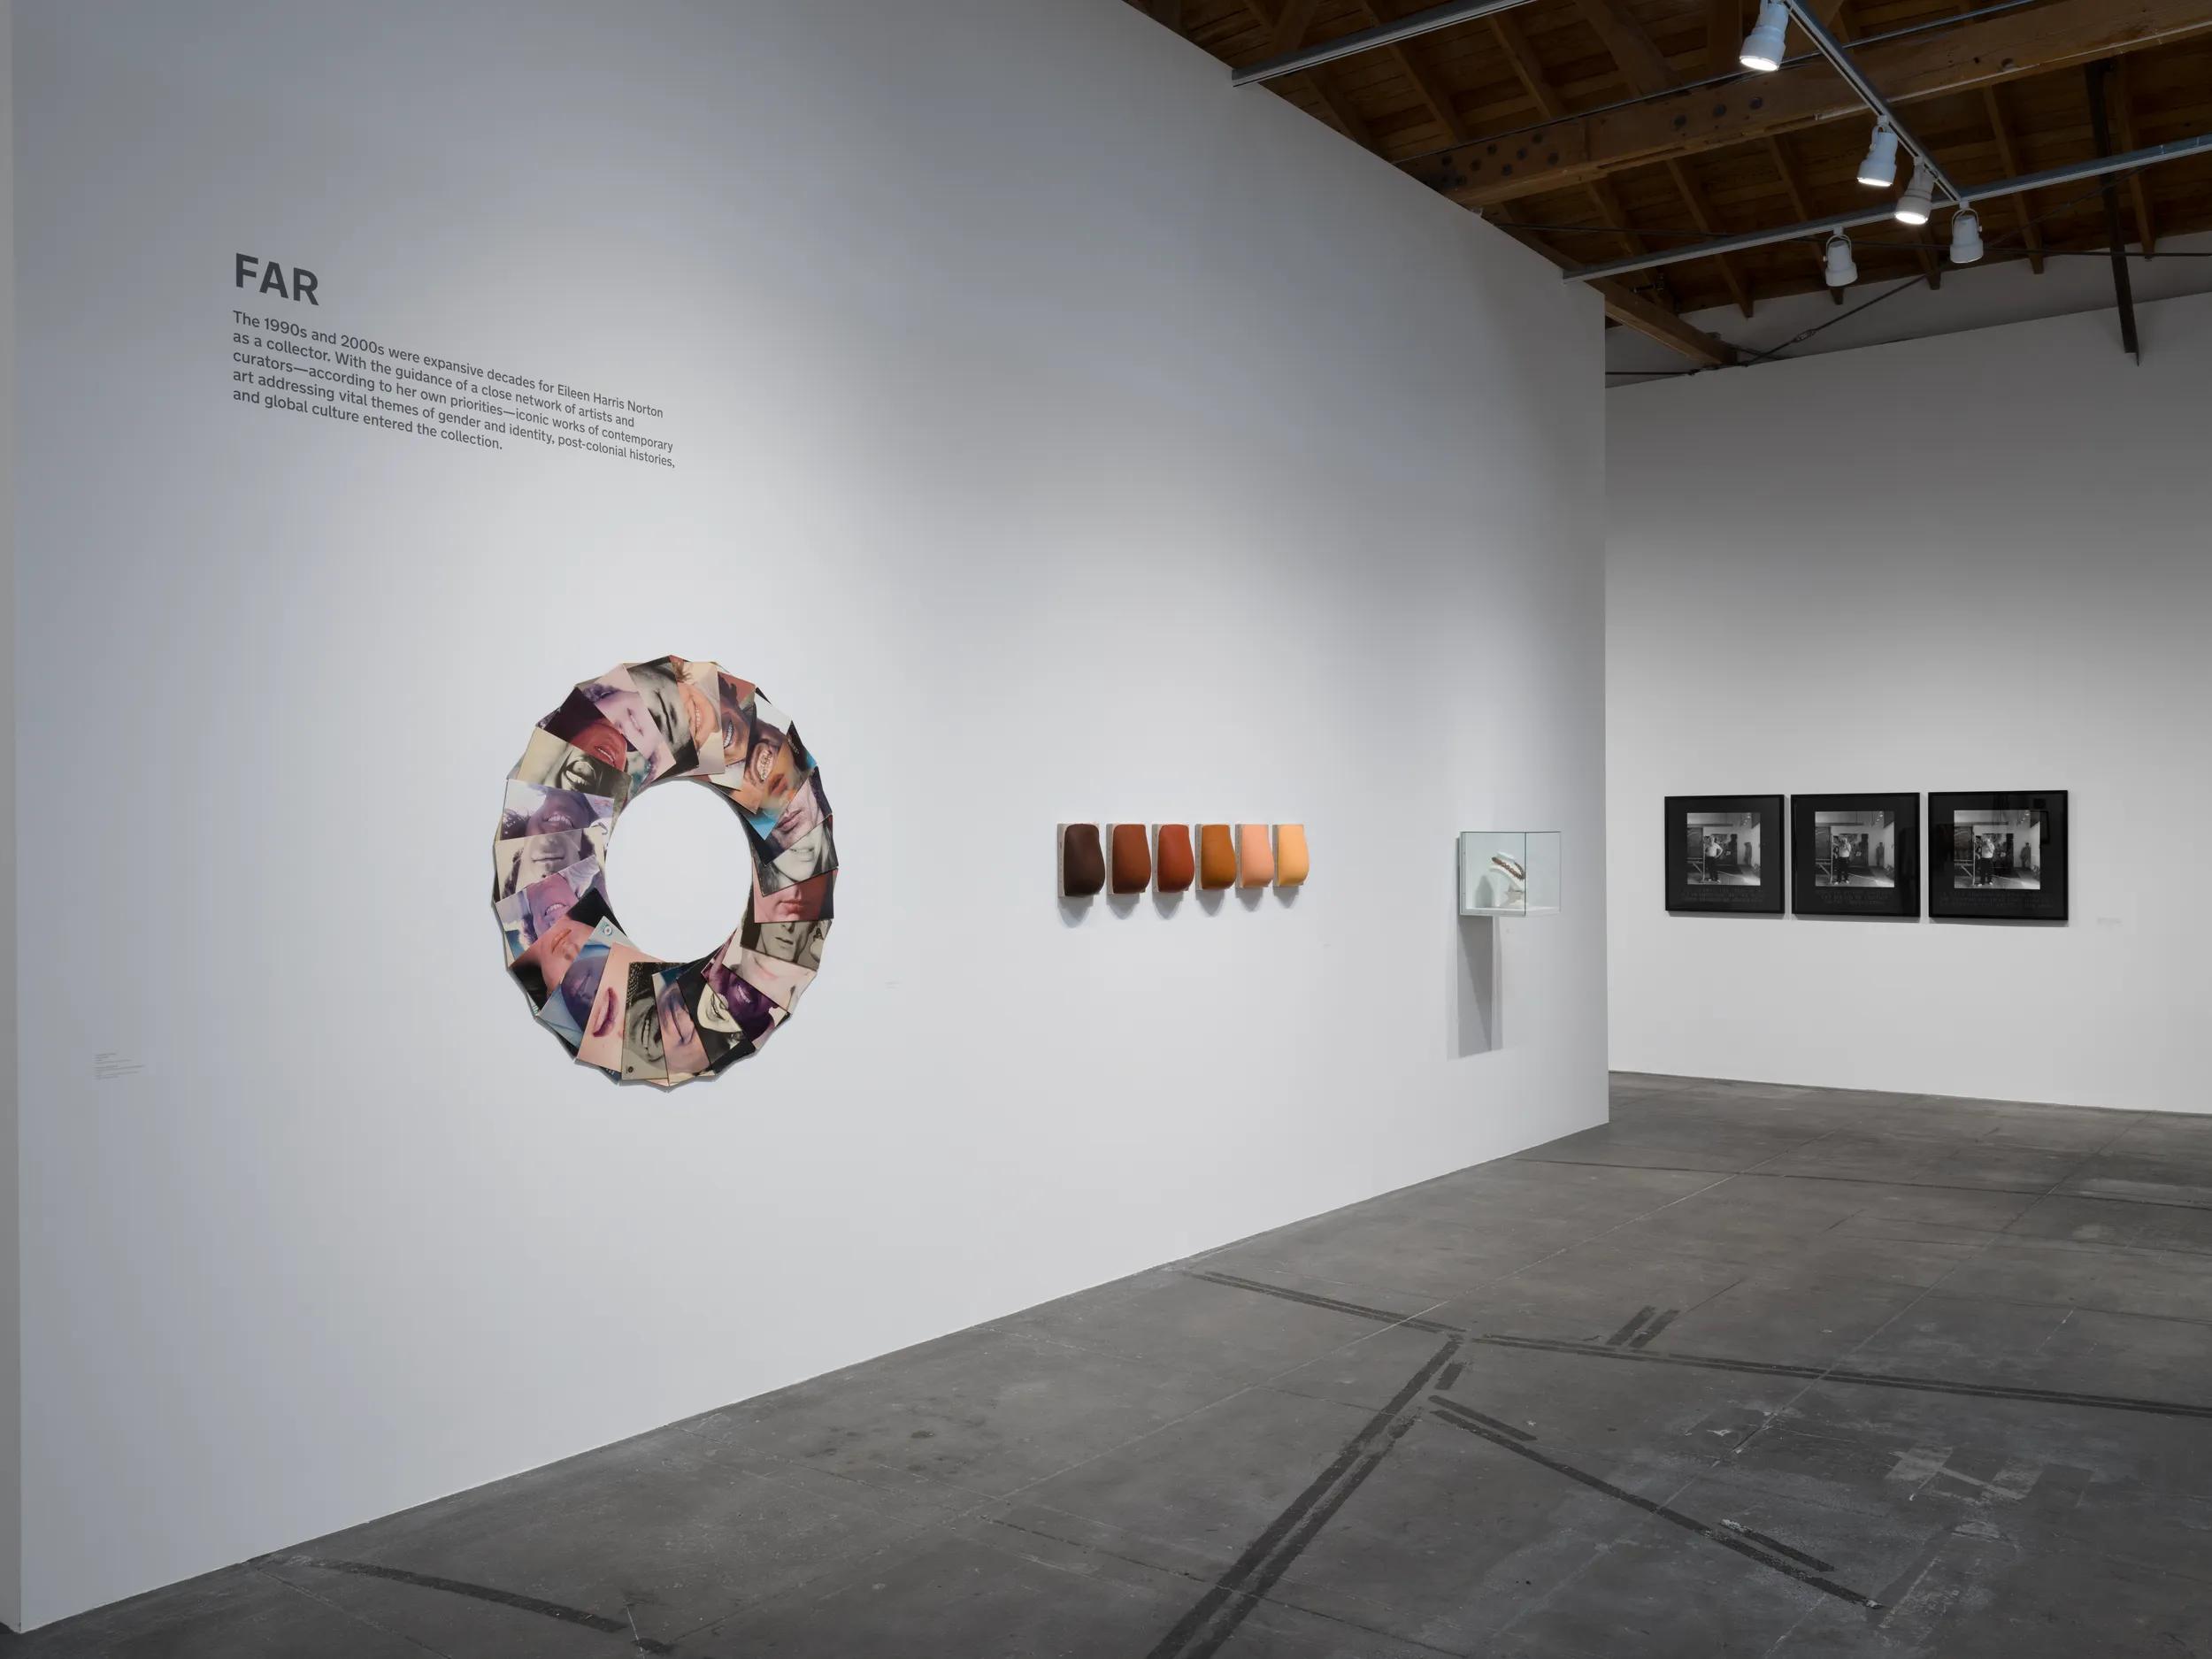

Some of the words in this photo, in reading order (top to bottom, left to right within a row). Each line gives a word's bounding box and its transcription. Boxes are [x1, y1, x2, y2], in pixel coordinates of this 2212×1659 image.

[235, 252, 319, 306] FAR
[233, 310, 260, 328] The
[264, 318, 308, 338] 1990s
[311, 331, 337, 345] and
[341, 334, 385, 356] 2000s
[388, 348, 420, 364] were
[423, 356, 484, 378] expansive
[487, 369, 536, 389] decades
[538, 380, 555, 394] for
[557, 383, 590, 403] Eileen
[593, 392, 625, 410] Harris
[627, 400, 663, 419] Norton
[233, 333, 250, 345] as
[253, 337, 263, 348] a
[266, 340, 331, 363] collector.
[334, 350, 367, 370] With
[370, 359, 392, 375] the
[395, 367, 453, 388] guidance
[455, 379, 469, 391] of
[471, 384, 479, 394] a
[481, 385, 512, 401] close
[515, 393, 562, 412] network
[565, 403, 577, 415] of
[578, 408, 613, 422] artists
[617, 416, 635, 428] and
[233, 371, 254, 384] art
[257, 375, 334, 402] addressing
[338, 390, 368, 406] vital
[370, 396, 419, 416] themes
[422, 406, 436, 419] of
[438, 411, 481, 428] gender
[484, 420, 506, 434] and
[509, 423, 555, 445] identity,
[557, 435, 627, 458] post-colonial
[629, 448, 675, 469] histories,
[233, 390, 260, 404] and
[265, 394, 309, 413] global
[311, 404, 360, 423] culture
[363, 415, 413, 433] entered
[416, 422, 437, 437] the
[441, 429, 503, 450] collection.
[379, 379, 393, 393] to
[396, 382, 418, 398] her
[419, 390, 447, 404] own
[552, 418, 587, 434] works
[588, 424, 600, 436] of
[601, 426, 673, 454] contemporary
